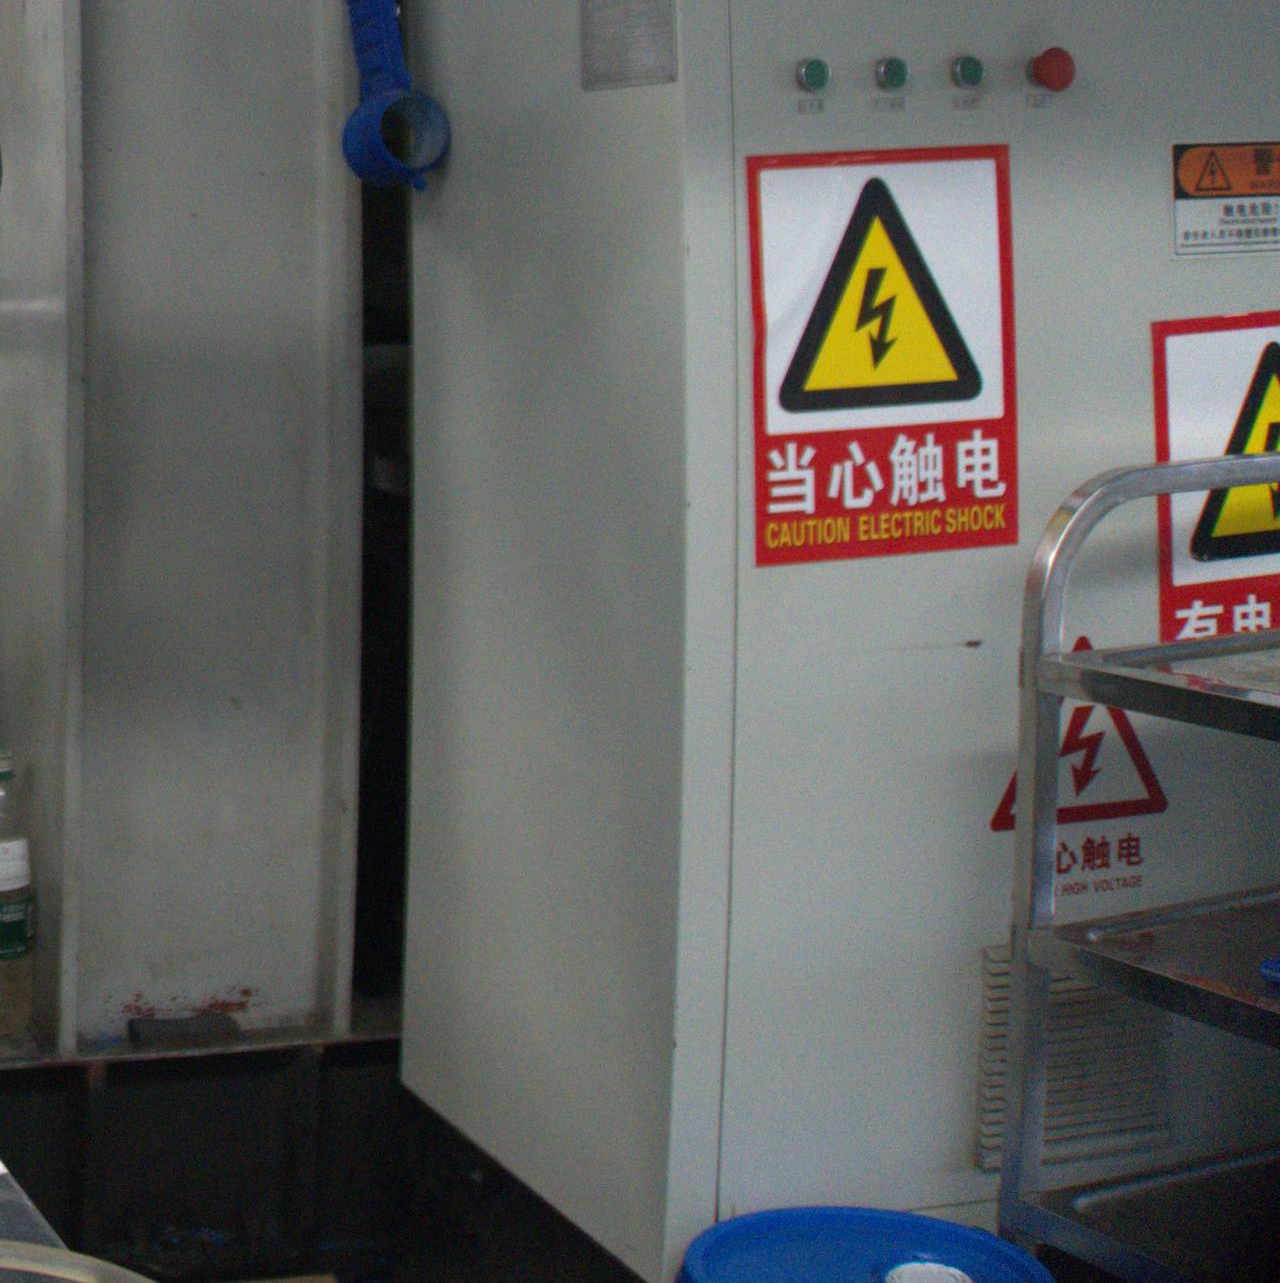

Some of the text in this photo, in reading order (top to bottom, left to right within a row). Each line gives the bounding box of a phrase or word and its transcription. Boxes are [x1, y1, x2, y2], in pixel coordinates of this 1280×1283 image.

[767, 428, 1006, 514] 当心触电
[766, 504, 1006, 549] CAUTION ELECTRIC SHOCK
[1062, 875, 1143, 895] HIGH VOLTAGE
